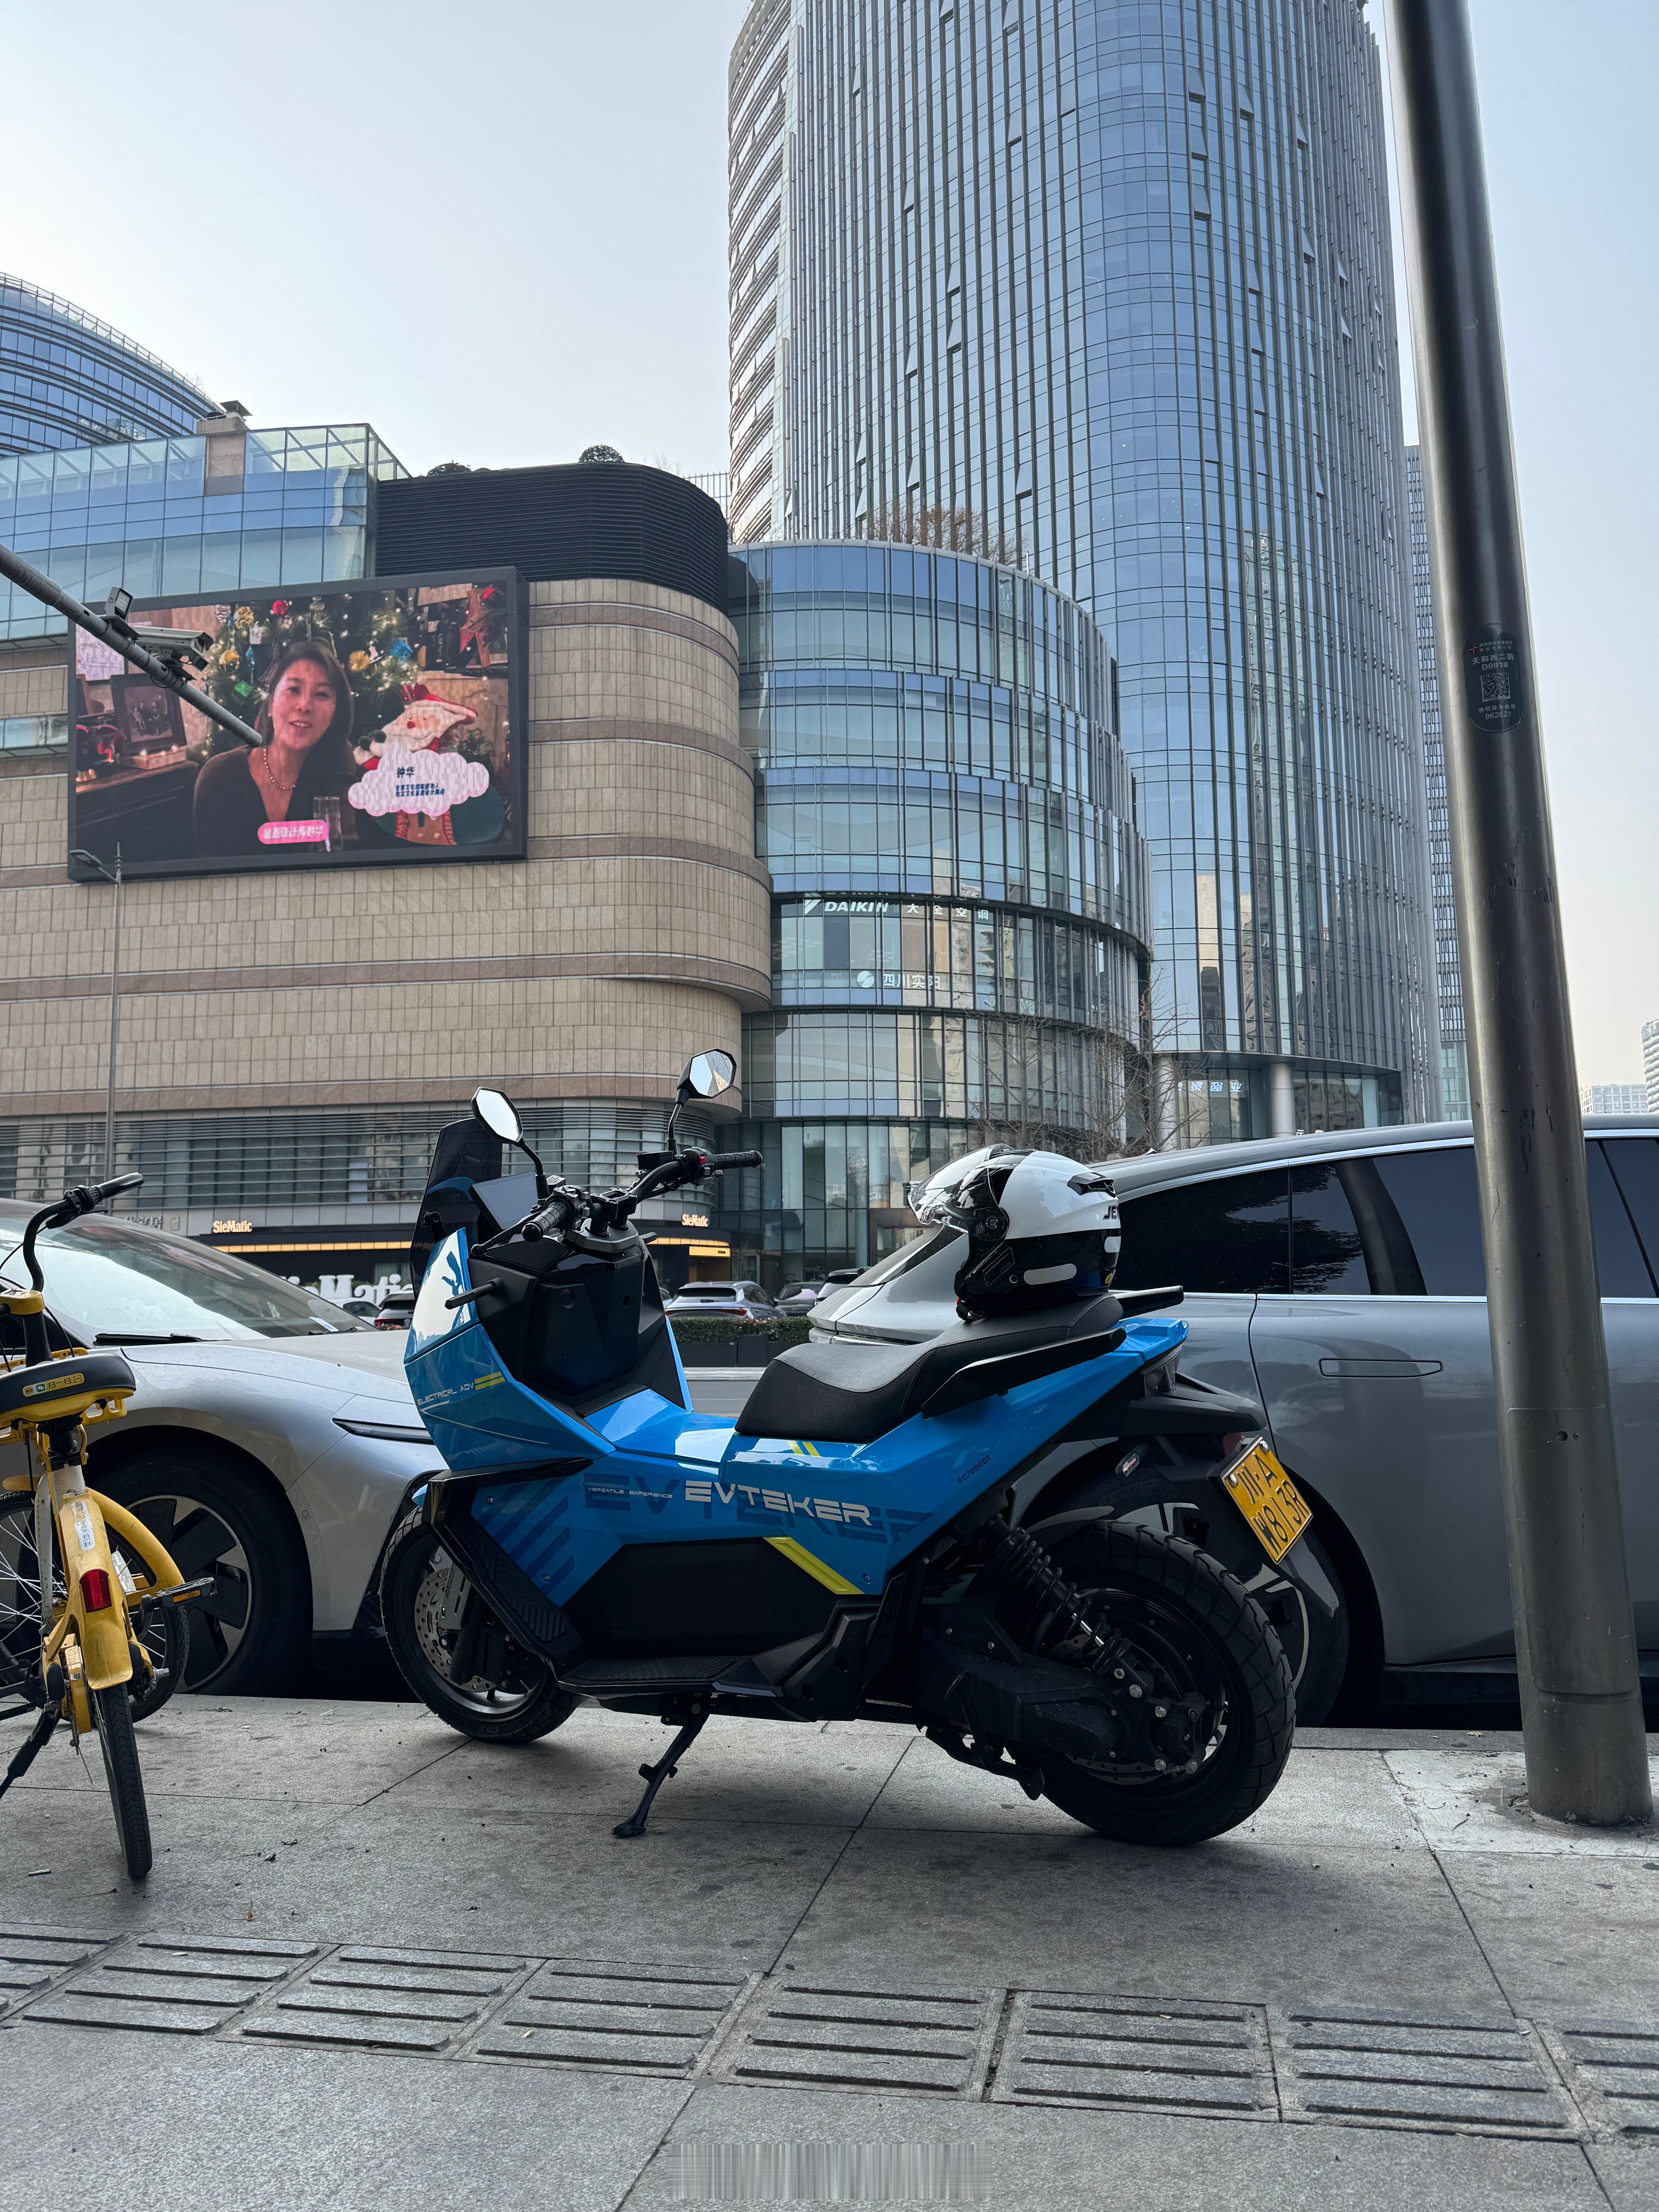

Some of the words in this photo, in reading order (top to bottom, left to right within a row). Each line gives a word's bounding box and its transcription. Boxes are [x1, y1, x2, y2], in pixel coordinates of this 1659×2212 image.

[1482, 661, 1508, 670] D0018
[1485, 711, 1511, 720] 962621
[824, 902, 889, 912] DAIKIN
[907, 903, 989, 920] 大金空调
[213, 1220, 252, 1233] SieMatic
[682, 1214, 708, 1227] SieMatic
[48, 1377, 71, 1389] 扫一扫
[417, 1388, 457, 1405] ELECTRICAL
[460, 1382, 474, 1392] ADV
[957, 1454, 992, 1484] GC7000DT
[629, 1490, 673, 1498] EXPERIENCE
[685, 1480, 872, 1526] EVTEKER
[1251, 1479, 1309, 1556] W813R
